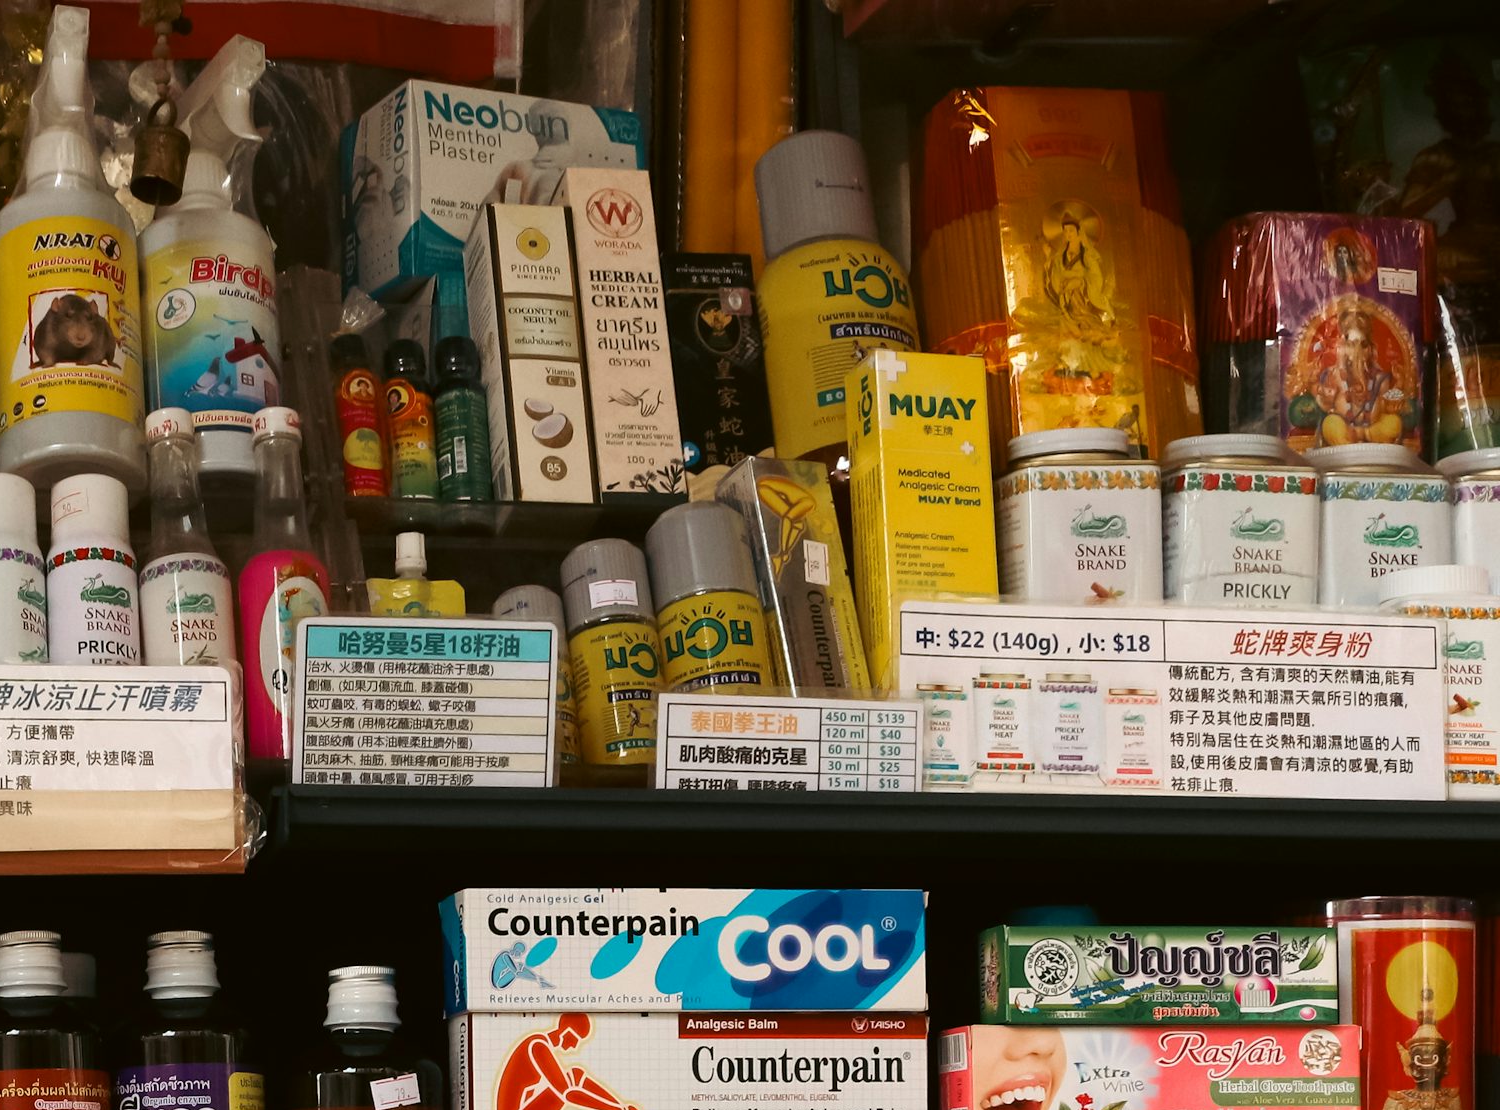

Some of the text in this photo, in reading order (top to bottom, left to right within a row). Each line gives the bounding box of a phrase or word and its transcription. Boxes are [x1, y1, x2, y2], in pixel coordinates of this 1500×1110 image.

[423, 90, 570, 142] Neobun
[427, 123, 501, 147] Menthol
[428, 140, 496, 165] Plaster
[34, 233, 97, 250] N.RAT
[594, 240, 643, 250] WORADA
[510, 264, 561, 275] PINNARA
[589, 270, 659, 285] HERBAL
[591, 284, 659, 293] MEDICATED
[591, 294, 659, 310] CREAM
[508, 307, 572, 317] COCONUT OIL
[523, 315, 557, 325] SERUM
[545, 367, 575, 377] Vitamin
[889, 393, 977, 421] MUAY
[898, 468, 951, 479] Medicated
[899, 481, 980, 494] Analgesic Cream
[1075, 543, 1127, 559] SNAKE
[1077, 557, 1127, 571] BRAND
[1222, 582, 1291, 600] PRICKLY
[85, 607, 131, 625] SNAKE
[87, 621, 131, 636] BRAND
[78, 640, 138, 661] PRICKLY
[338, 630, 520, 658] 哈努曼5星18籽油
[948, 630, 985, 649] $22
[992, 632, 1059, 655] (140g)
[1113, 634, 1150, 653] $18
[1230, 629, 1373, 658] 蛇牌爽身粉
[691, 710, 799, 735] 泰國拳王油
[826, 711, 905, 725] 450 ml $139
[7, 724, 75, 741] 方便攜帶
[880, 729, 901, 741] $40
[7, 749, 80, 766] 清涼舒爽,
[86, 750, 154, 766] 快速降溫
[679, 744, 808, 767] 肌肉酸痛的克星
[878, 778, 900, 790] $18
[488, 907, 699, 943] Counterpain
[717, 914, 890, 981] COOL
[686, 1018, 779, 1032] Analgesic Balm
[870, 1020, 906, 1030] TAISHO
[1158, 1030, 1285, 1080] Rasyan
[691, 1045, 906, 1092] Counterpain
[1074, 1060, 1131, 1085] Extra
[1102, 1077, 1145, 1095] White
[142, 1095, 211, 1107] Organic enzyme
